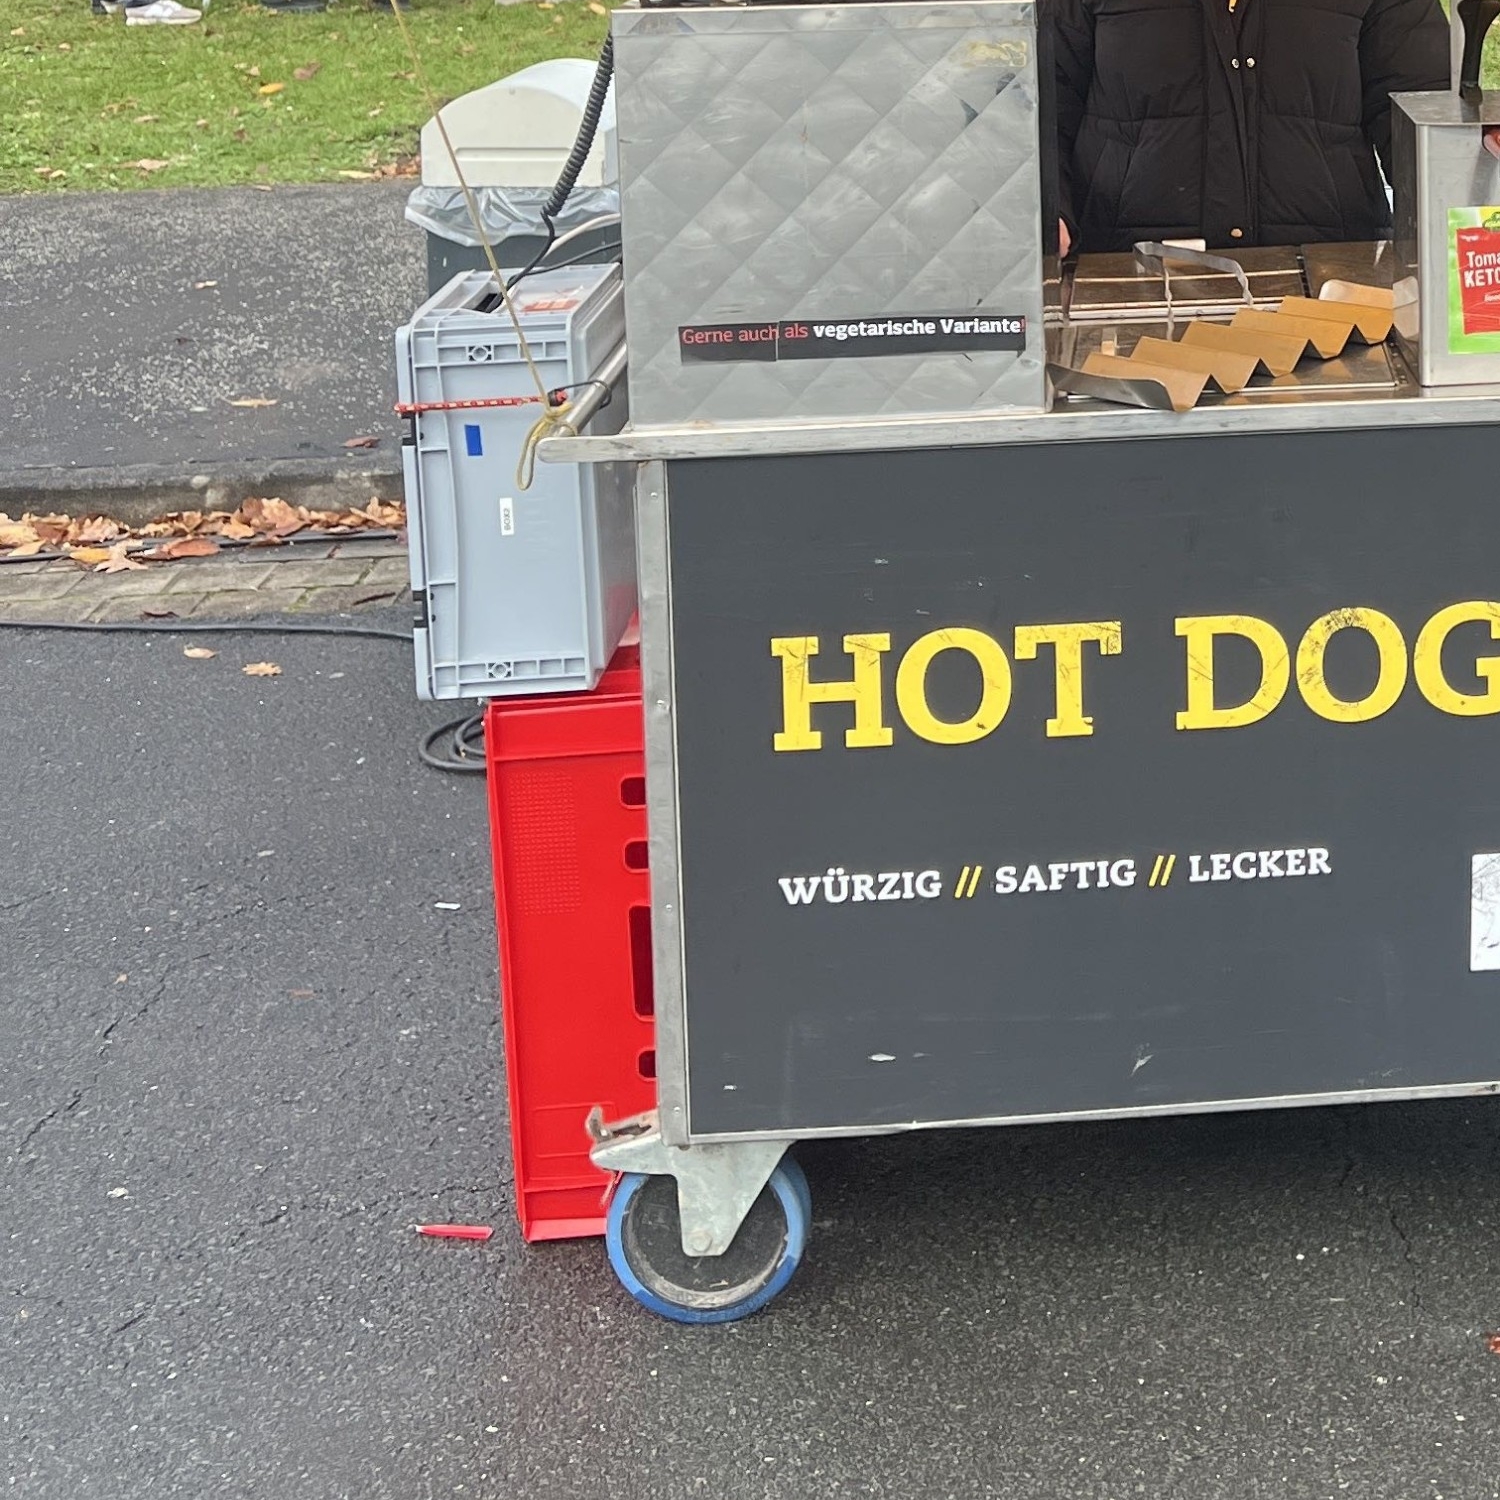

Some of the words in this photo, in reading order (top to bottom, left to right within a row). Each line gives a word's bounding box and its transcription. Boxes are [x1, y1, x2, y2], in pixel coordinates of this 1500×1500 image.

[682, 328, 733, 345] Gerne
[738, 325, 779, 342] auch
[784, 323, 808, 339] als
[813, 319, 935, 340] vegetarische
[771, 620, 1122, 752] HOT
[778, 867, 942, 904] WÜRZIG
[994, 858, 1137, 894] SAFTIG
[1188, 847, 1332, 882] LECKER
